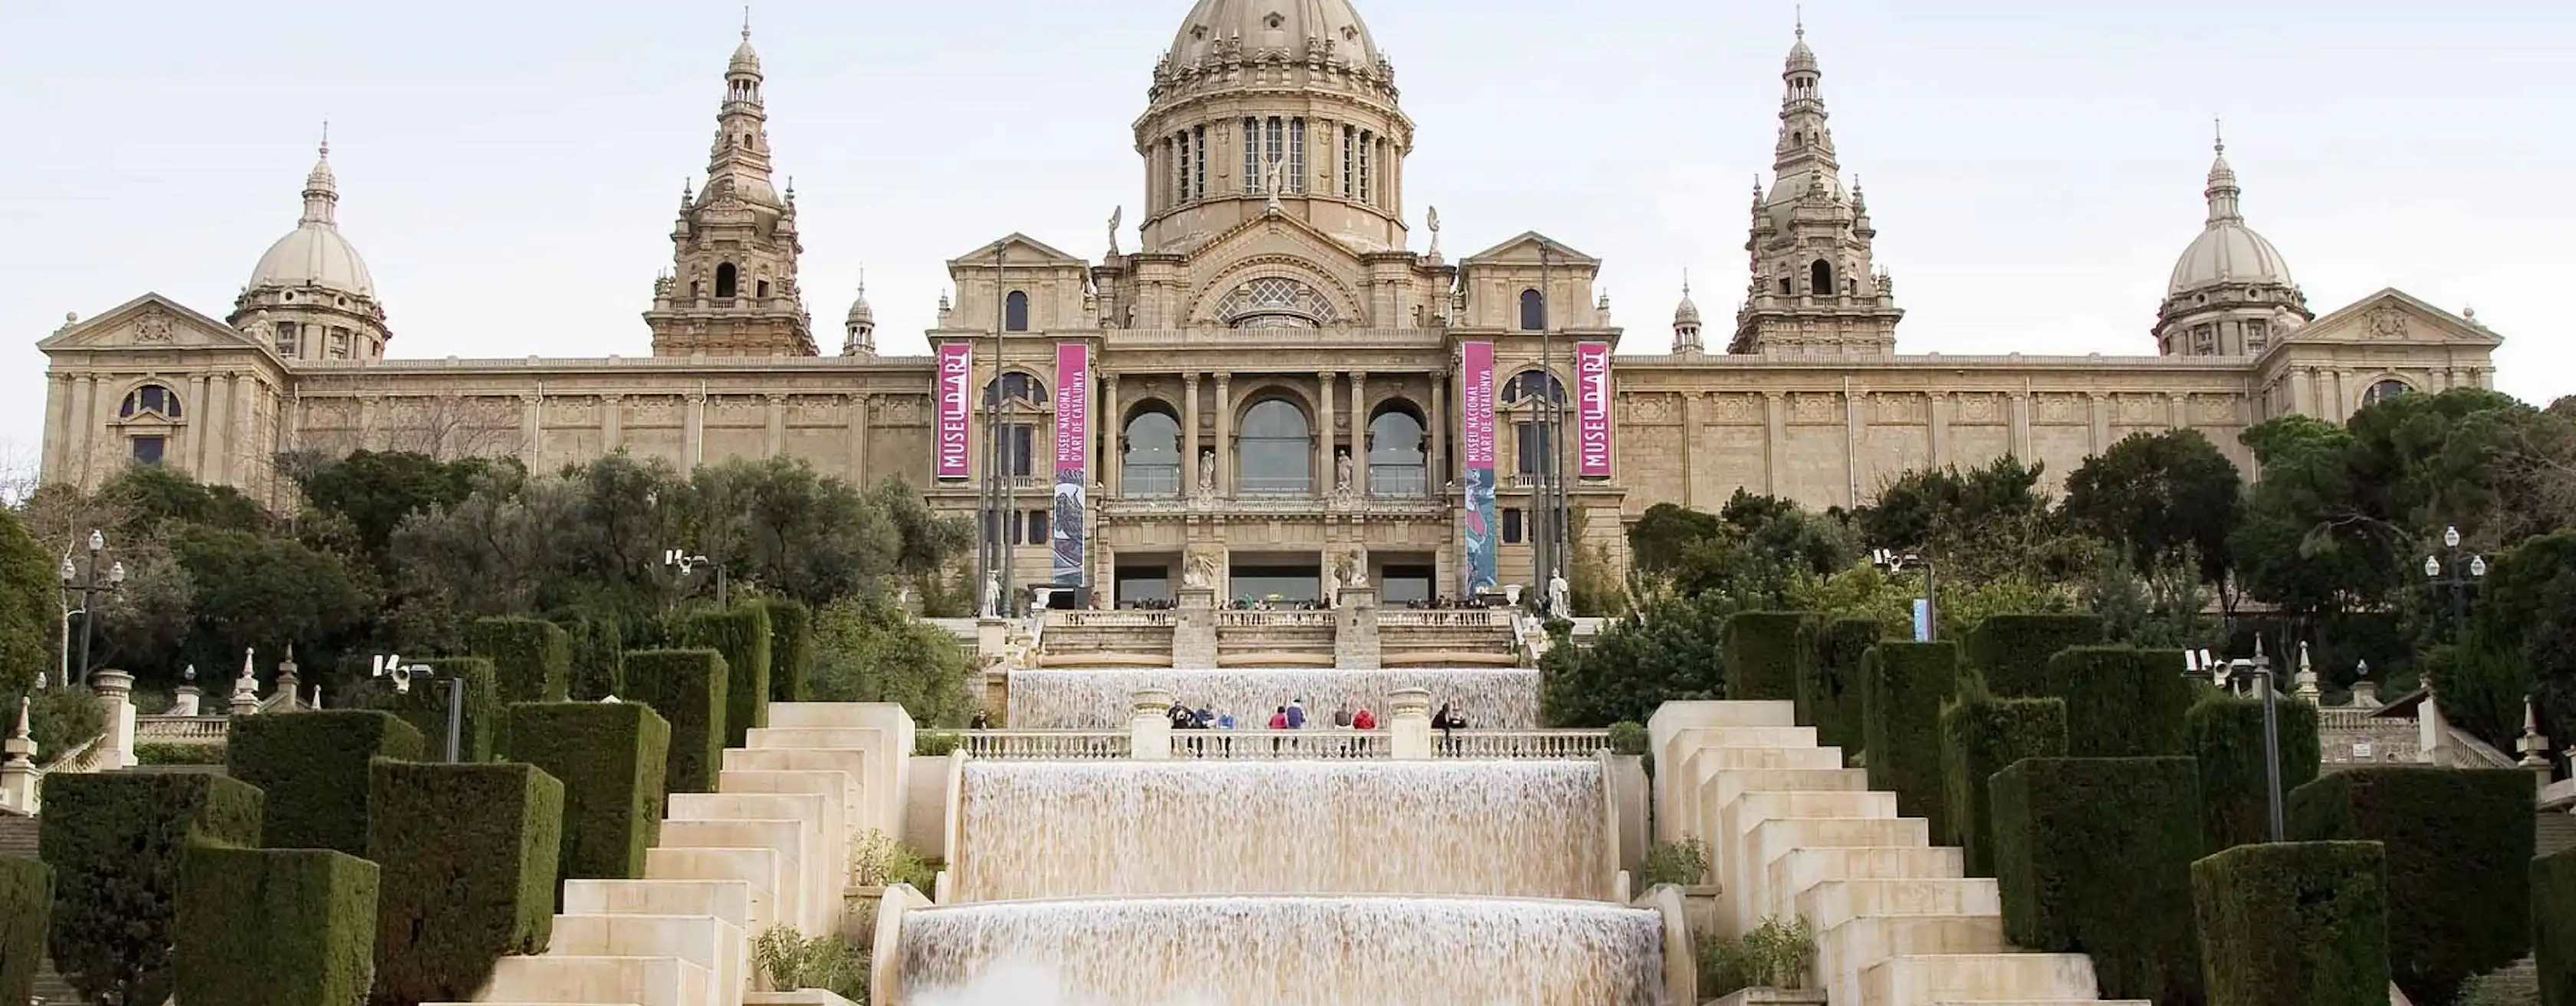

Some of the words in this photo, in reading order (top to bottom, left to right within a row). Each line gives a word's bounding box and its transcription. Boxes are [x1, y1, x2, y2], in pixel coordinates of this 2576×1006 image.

[1059, 386, 1071, 429] NACIONAL
[1073, 371, 1084, 418] CATALUNYA
[1467, 385, 1479, 429] NACIONAL
[1479, 370, 1492, 418] CATALUNYA
[944, 409, 964, 468] MUSEU
[1073, 421, 1083, 432] DE
[1480, 420, 1492, 432] DE
[1585, 410, 1606, 466] MUSEU
[1058, 432, 1071, 461] MUSEU
[1071, 436, 1083, 462] D'ART
[1467, 433, 1480, 461] MUSEU
[1481, 436, 1493, 462] D'ART
